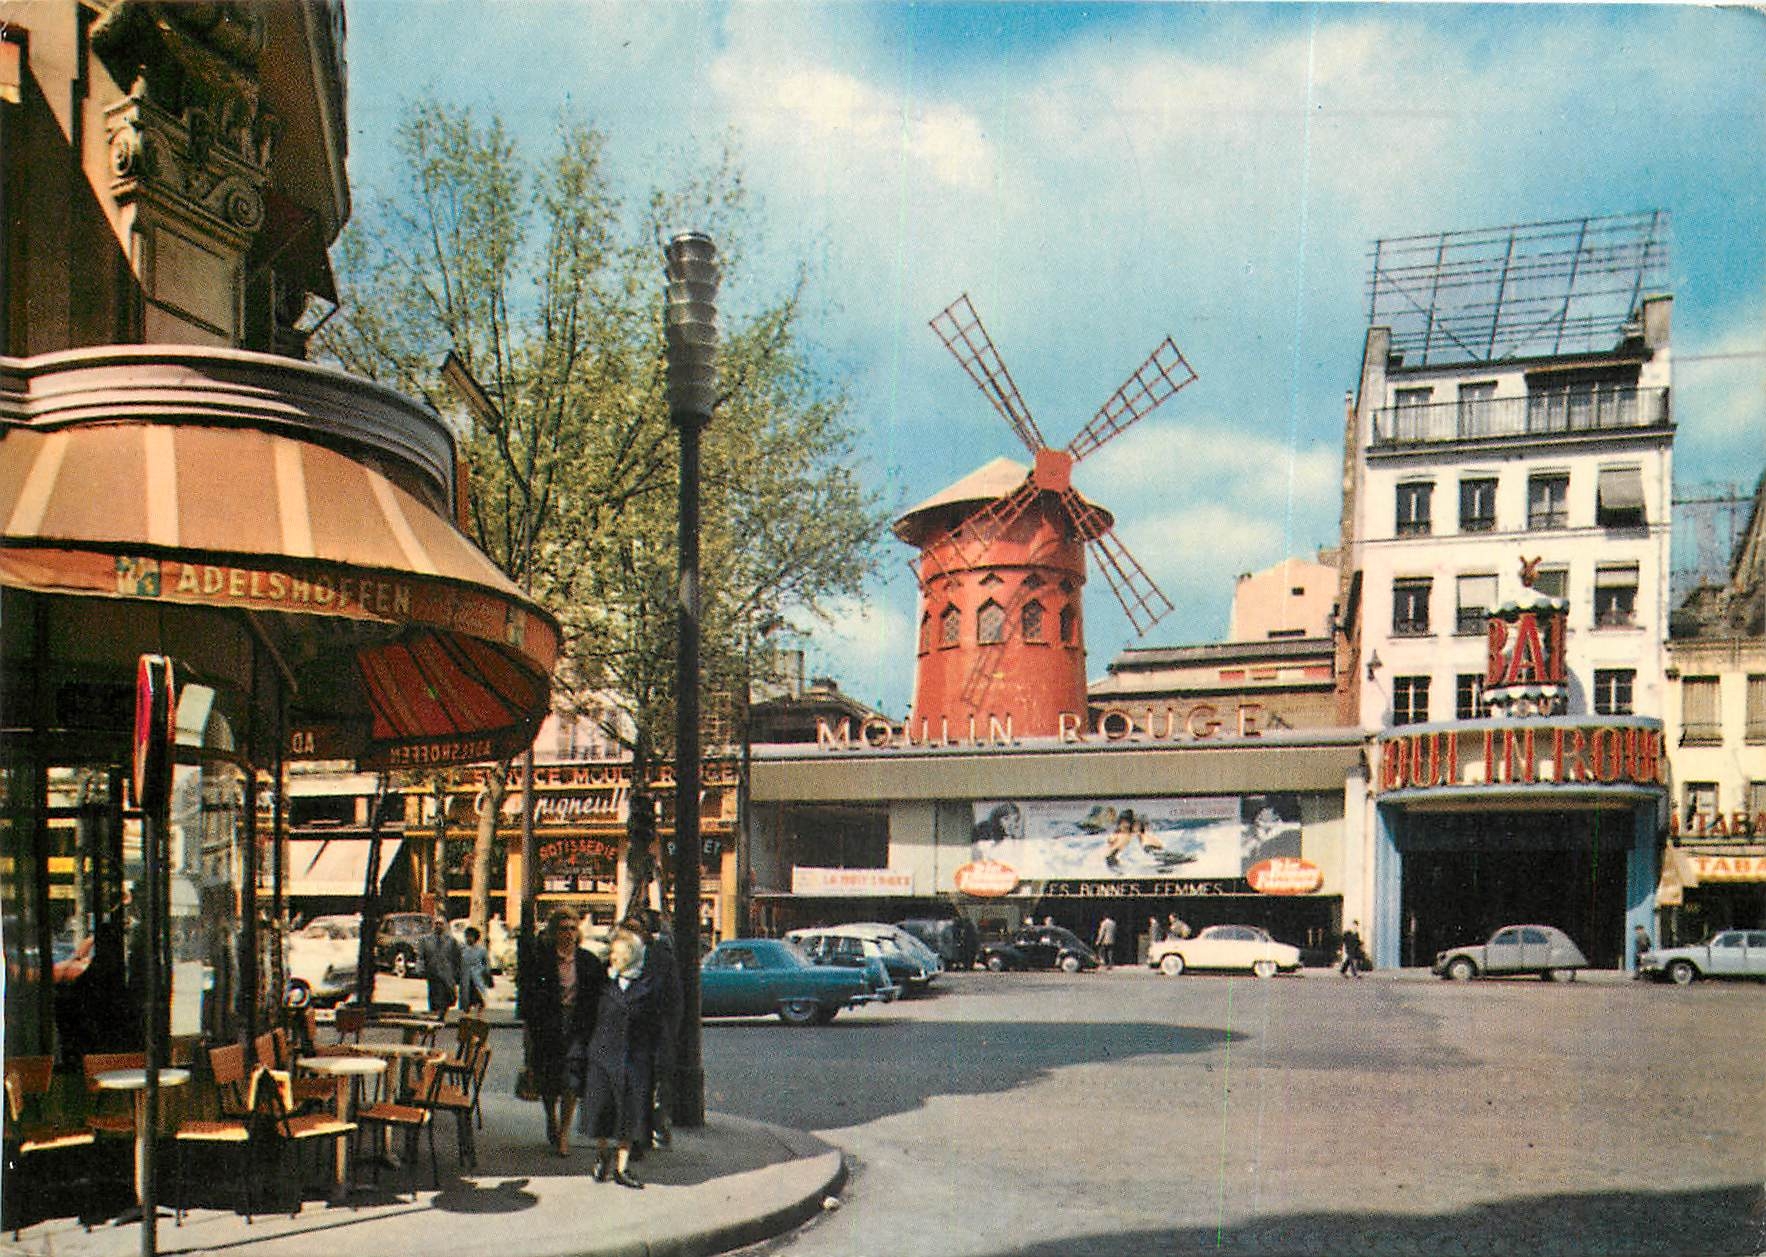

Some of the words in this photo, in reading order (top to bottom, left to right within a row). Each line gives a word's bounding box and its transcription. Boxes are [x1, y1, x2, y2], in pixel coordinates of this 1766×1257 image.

[177, 563, 412, 615] ADELSHOFFEN
[1488, 612, 1567, 686] BAL
[816, 714, 1013, 750] MOULIN
[1058, 703, 1263, 744] ROUGE
[1080, 882, 1140, 896] BONNES
[1154, 882, 1223, 896] FEMMES
